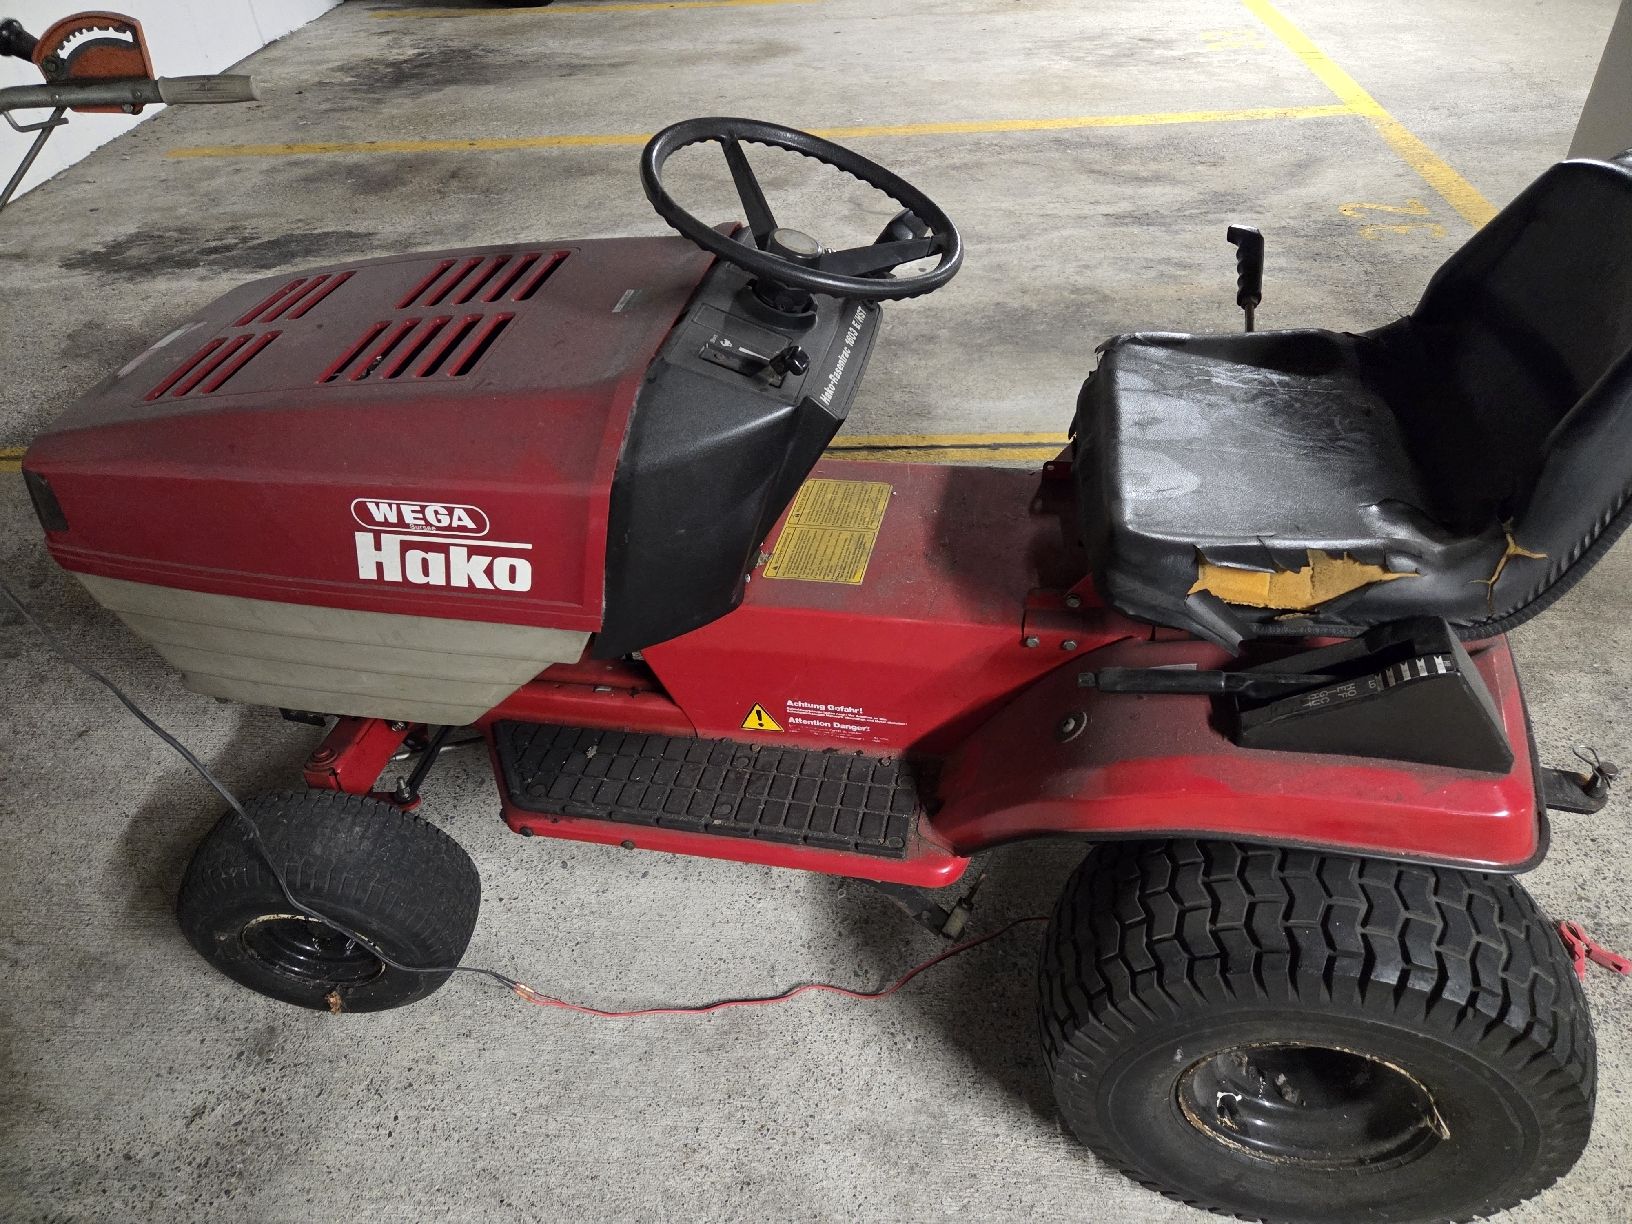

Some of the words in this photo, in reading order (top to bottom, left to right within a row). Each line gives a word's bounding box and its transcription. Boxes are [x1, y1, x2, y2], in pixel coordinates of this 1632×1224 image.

[366, 502, 477, 528] WEGA
[354, 531, 533, 592] Hako
[787, 700, 826, 710] Achtung
[788, 717, 831, 727] Attention
